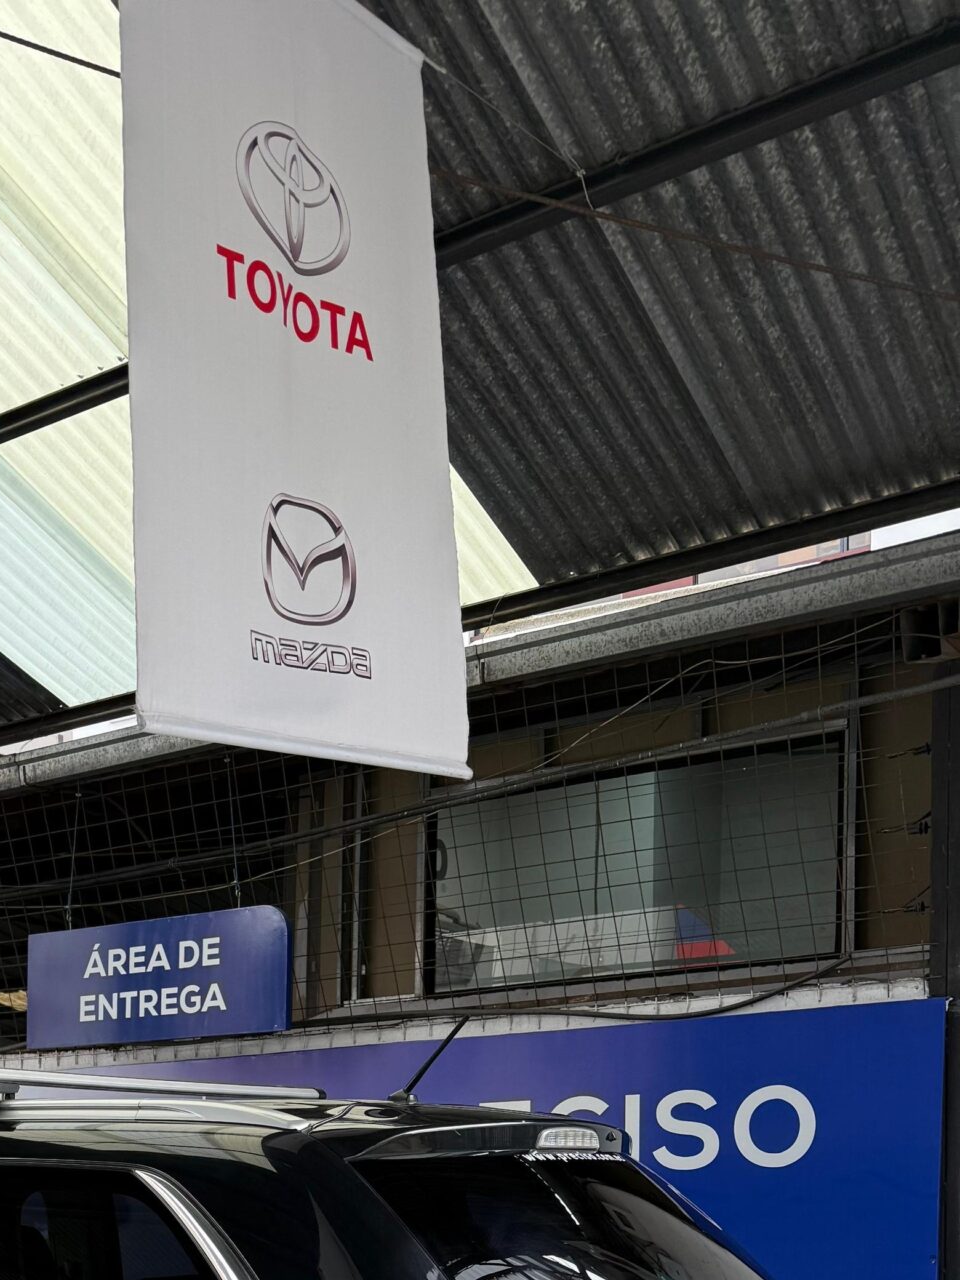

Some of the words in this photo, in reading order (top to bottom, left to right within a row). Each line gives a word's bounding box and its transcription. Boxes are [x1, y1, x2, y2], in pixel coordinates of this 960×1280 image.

[216, 243, 374, 362] TOYOTA
[83, 943, 171, 979] ÁREA
[178, 936, 221, 970] DE
[79, 982, 227, 1022] ENTREGA
